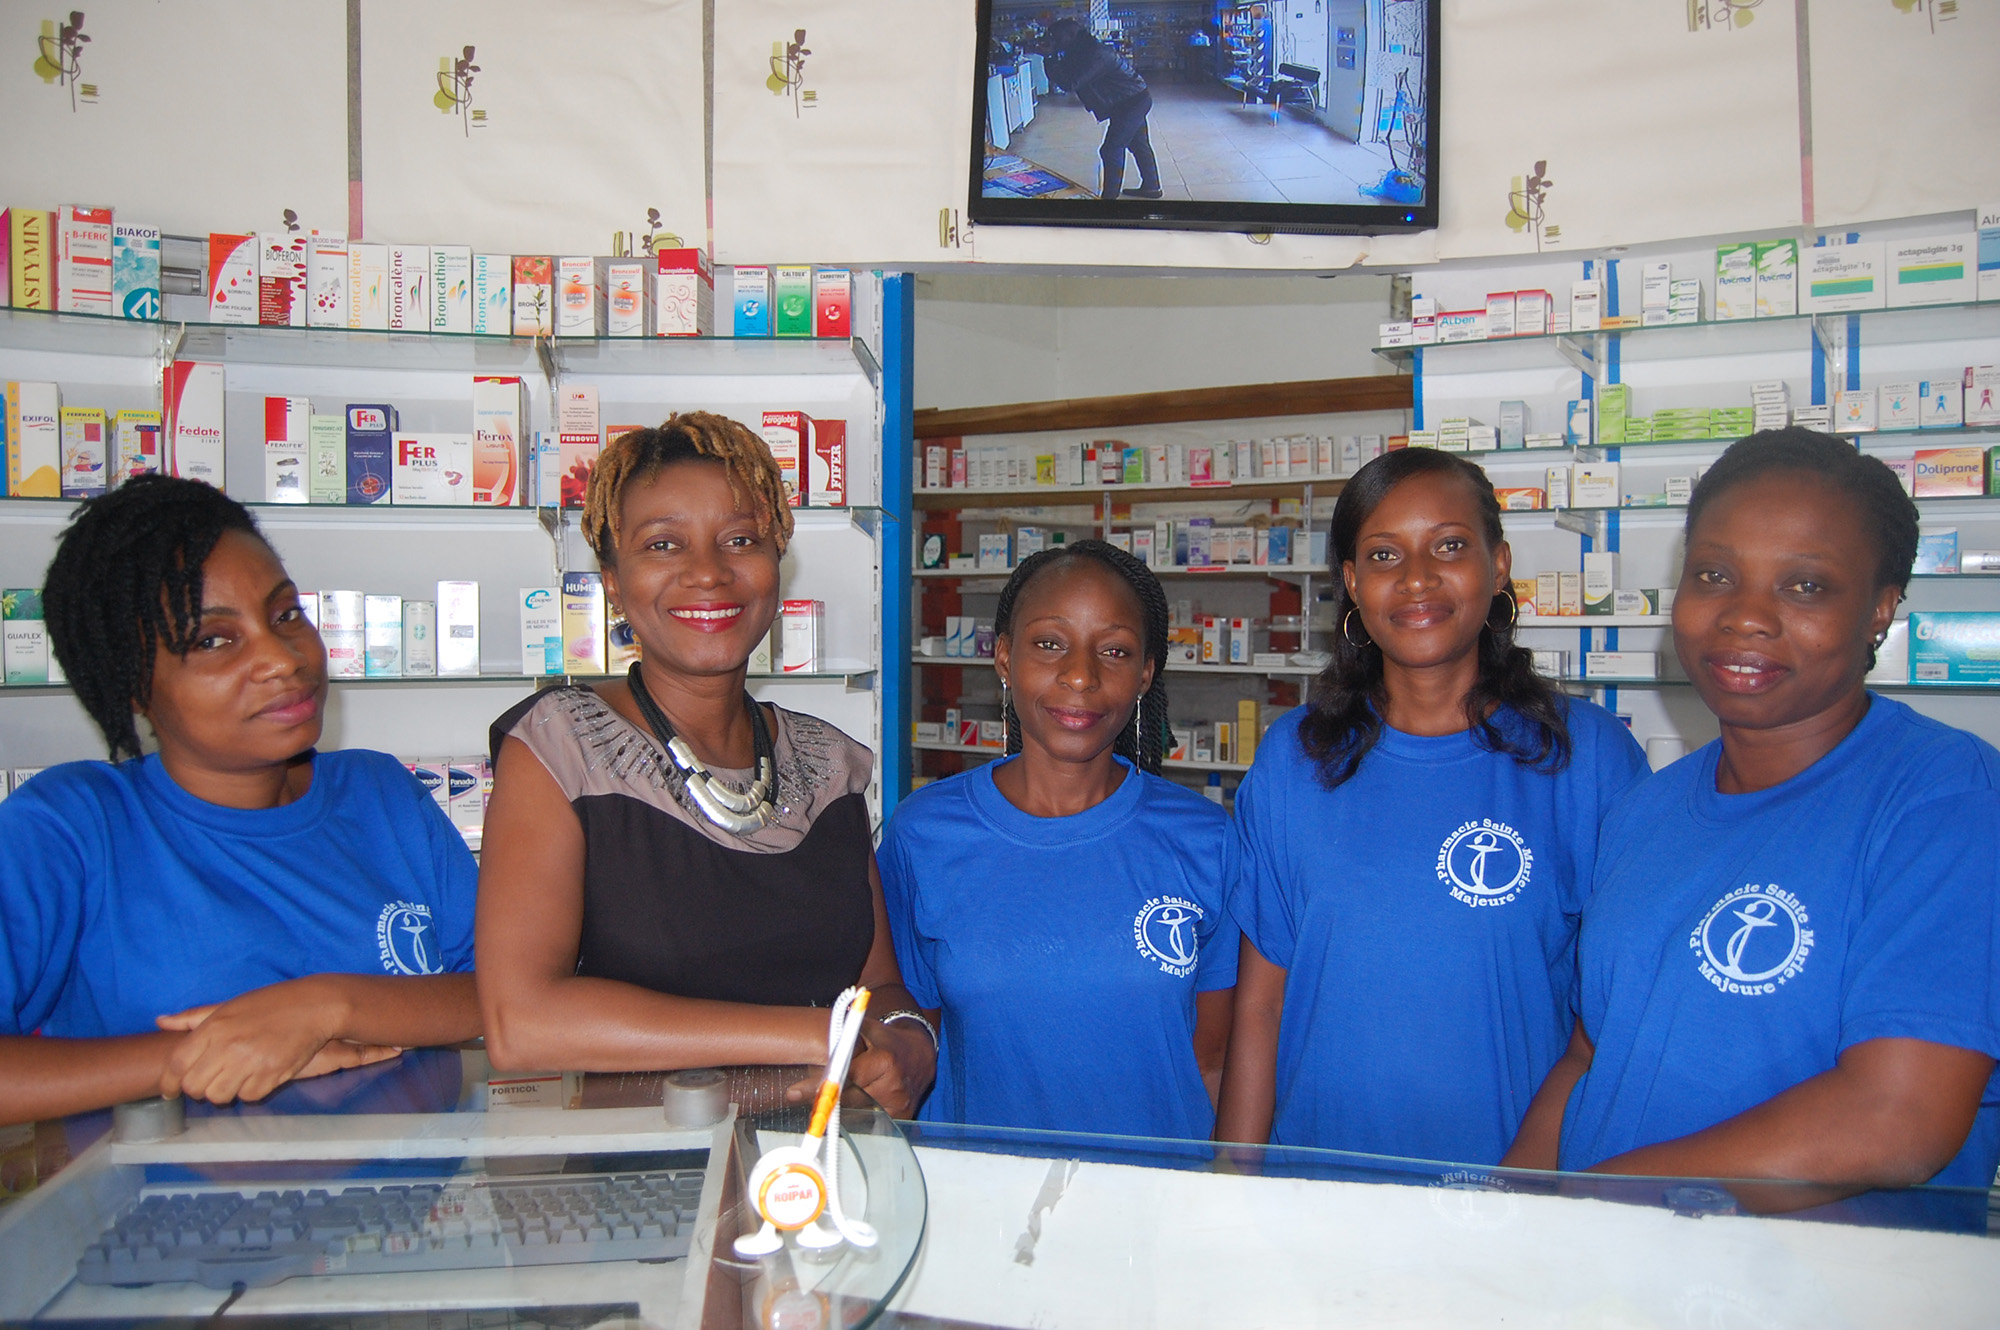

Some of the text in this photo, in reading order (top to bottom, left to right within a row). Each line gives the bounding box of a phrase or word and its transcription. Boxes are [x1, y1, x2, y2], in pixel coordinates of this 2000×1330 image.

[72, 231, 108, 242] B-FERIC
[116, 226, 158, 239] BIAKOF
[23, 215, 40, 310] ASTYMIN
[265, 249, 301, 262] BIOFERON
[1898, 246, 1949, 257] actapulgite
[1812, 262, 1859, 274] actapulgite
[349, 250, 361, 329] Broncalène
[391, 250, 403, 329] Broncalène
[434, 251, 446, 327] Broncathiol
[474, 256, 487, 334] Broncathiol
[22, 415, 55, 423] EXIFOL
[356, 410, 377, 427] FER
[179, 425, 220, 437] Fedate
[476, 429, 513, 442] Ferox
[398, 440, 436, 466] FER
[1917, 463, 1979, 475] Doliprane
[565, 583, 600, 593] HUME
[1435, 818, 1534, 888] Pharmacie Sainte Marie
[1449, 886, 1515, 908] Majeure
[1765, 883, 1809, 924] Sainte
[376, 902, 398, 971] Pharmacie
[1133, 897, 1160, 959] Pharmacie
[1783, 929, 1815, 978] Marie
[1697, 960, 1776, 996] Majeure
[492, 1085, 537, 1095] FORTICOL
